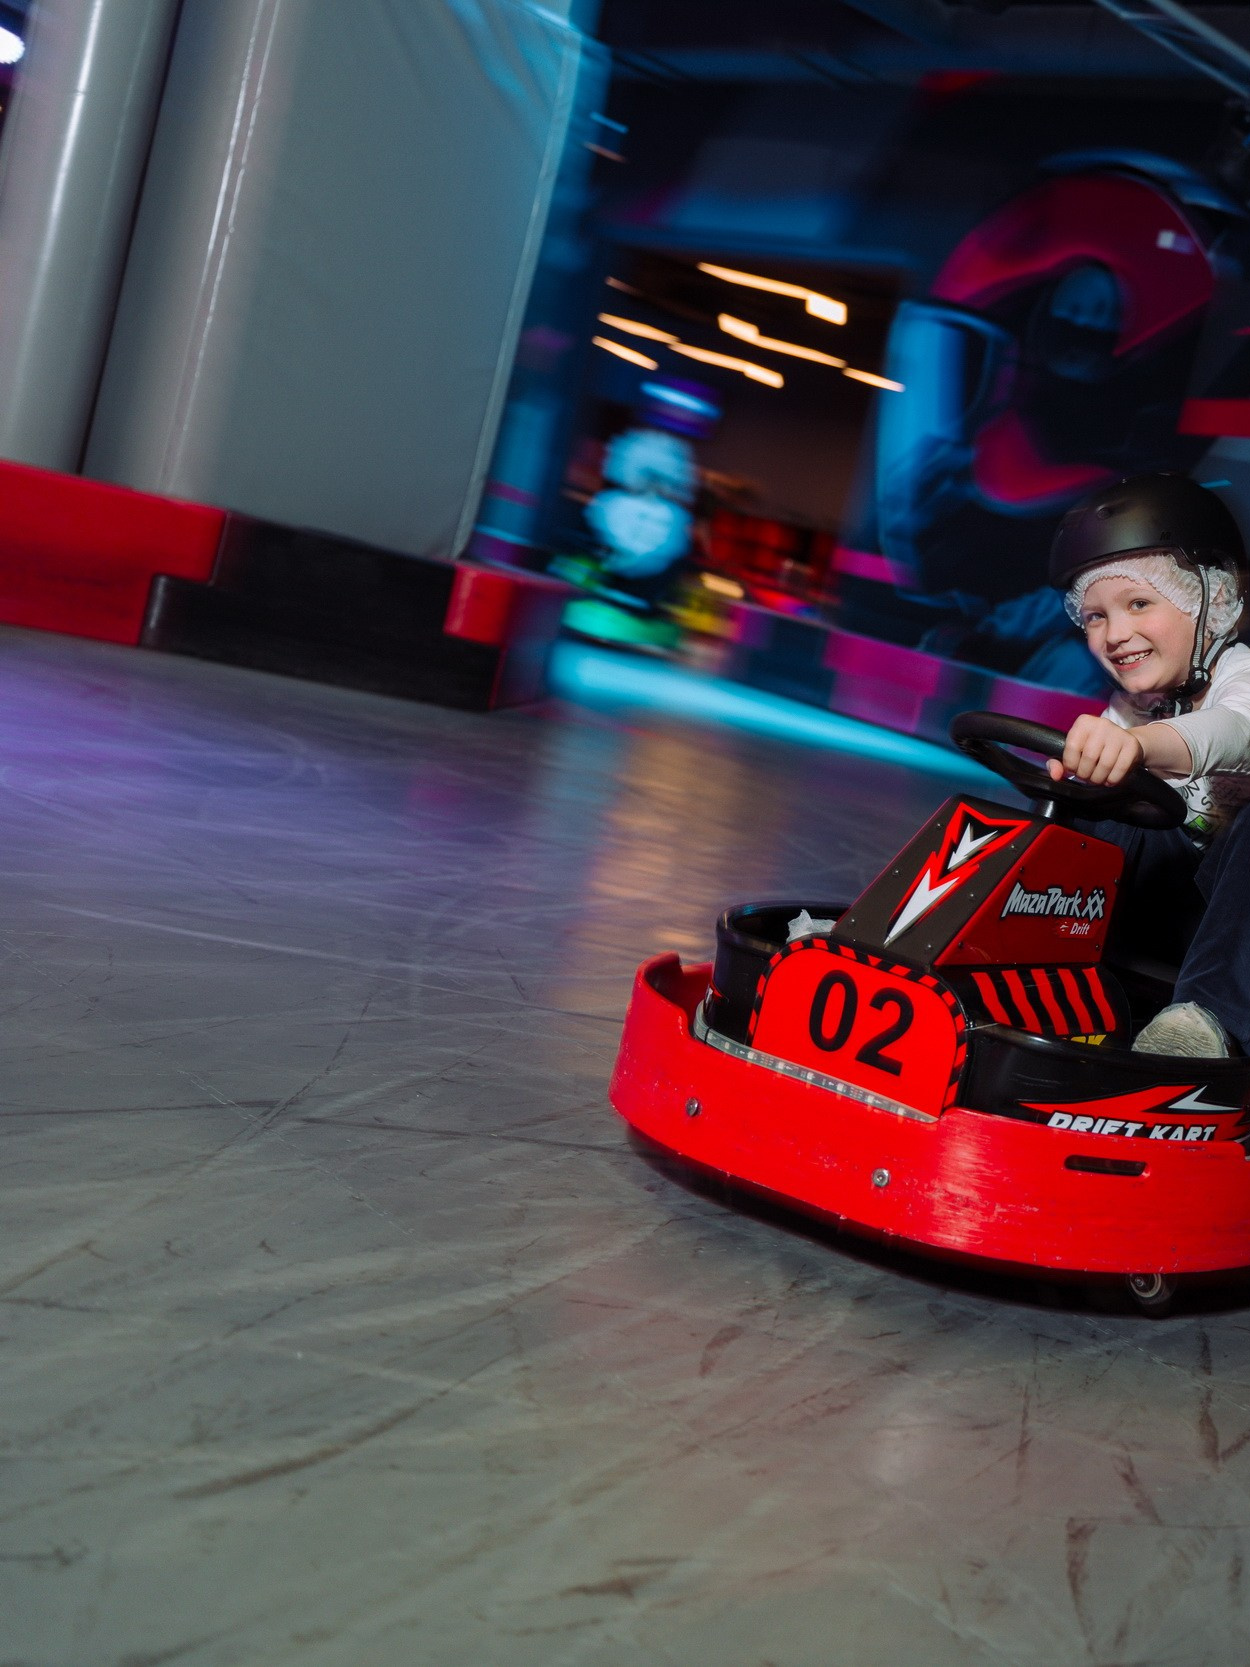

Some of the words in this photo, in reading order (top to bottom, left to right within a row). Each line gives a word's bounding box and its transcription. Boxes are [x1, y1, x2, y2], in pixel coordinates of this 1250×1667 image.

[1001, 882, 1082, 918] MazaPark
[1069, 922, 1090, 935] Drift
[808, 970, 914, 1077] 02
[1047, 1111, 1144, 1138] DRIFT
[1149, 1125, 1217, 1141] KART
